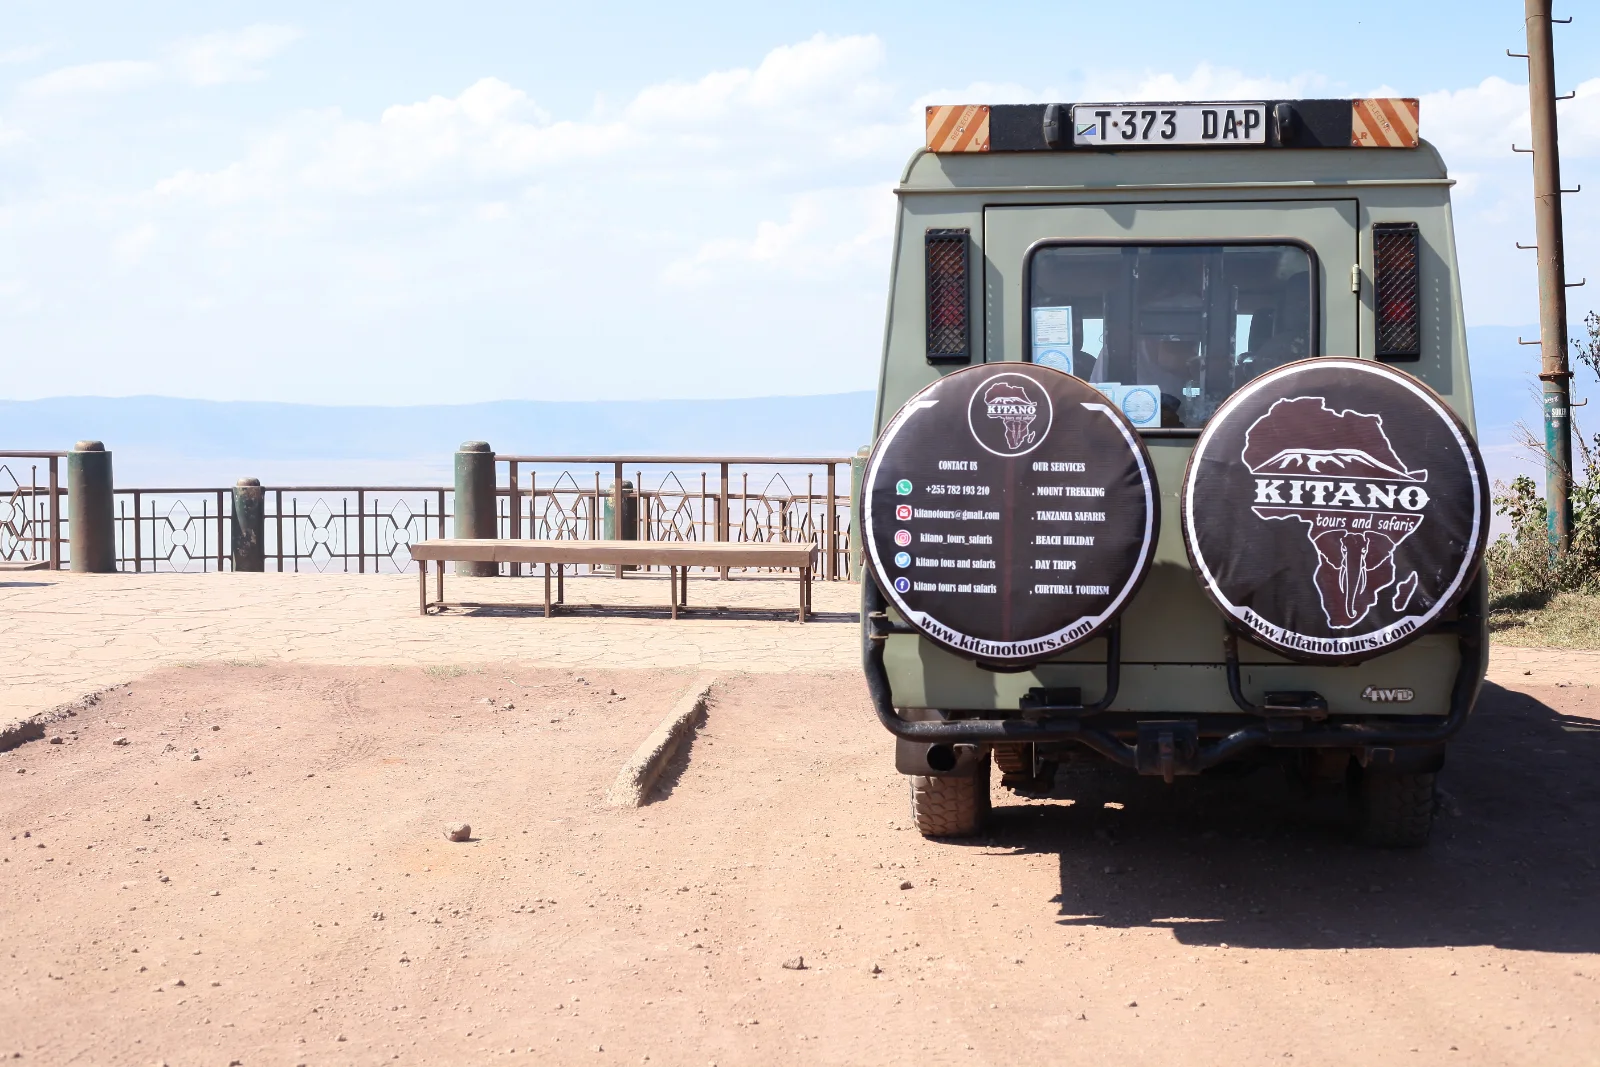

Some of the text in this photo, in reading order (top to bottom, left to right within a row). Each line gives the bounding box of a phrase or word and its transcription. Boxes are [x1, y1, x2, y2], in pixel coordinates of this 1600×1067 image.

[1364, 98, 1391, 134] EFLECTIVE
[1095, 109, 1260, 140] T 373 DAP
[987, 405, 1036, 415] KITANO
[938, 460, 978, 471] CONTACT US
[1032, 461, 1086, 472] OUR SERVICES
[925, 484, 990, 496] +255 782 193 210
[1036, 486, 1106, 497] MOUNT TREKKING
[1254, 479, 1431, 511] KITANO
[914, 508, 1000, 521] kitanotours@gmail.com
[1036, 510, 1106, 522] TANZANIA SAFARIS
[1315, 513, 1415, 532] tours and safaris
[1035, 535, 1095, 546] BEACH HILIDAY
[915, 557, 996, 569] kitano tous and safaris
[1034, 559, 1077, 570] DAY TRIPS
[913, 581, 997, 594] kitano tours and safaris
[1034, 584, 1110, 595] CURTURAL TOURISM
[920, 615, 1094, 658] www.kitanotours.com
[1243, 609, 1417, 654] www.kitanotours.com
[1361, 685, 1415, 702] 4WD
